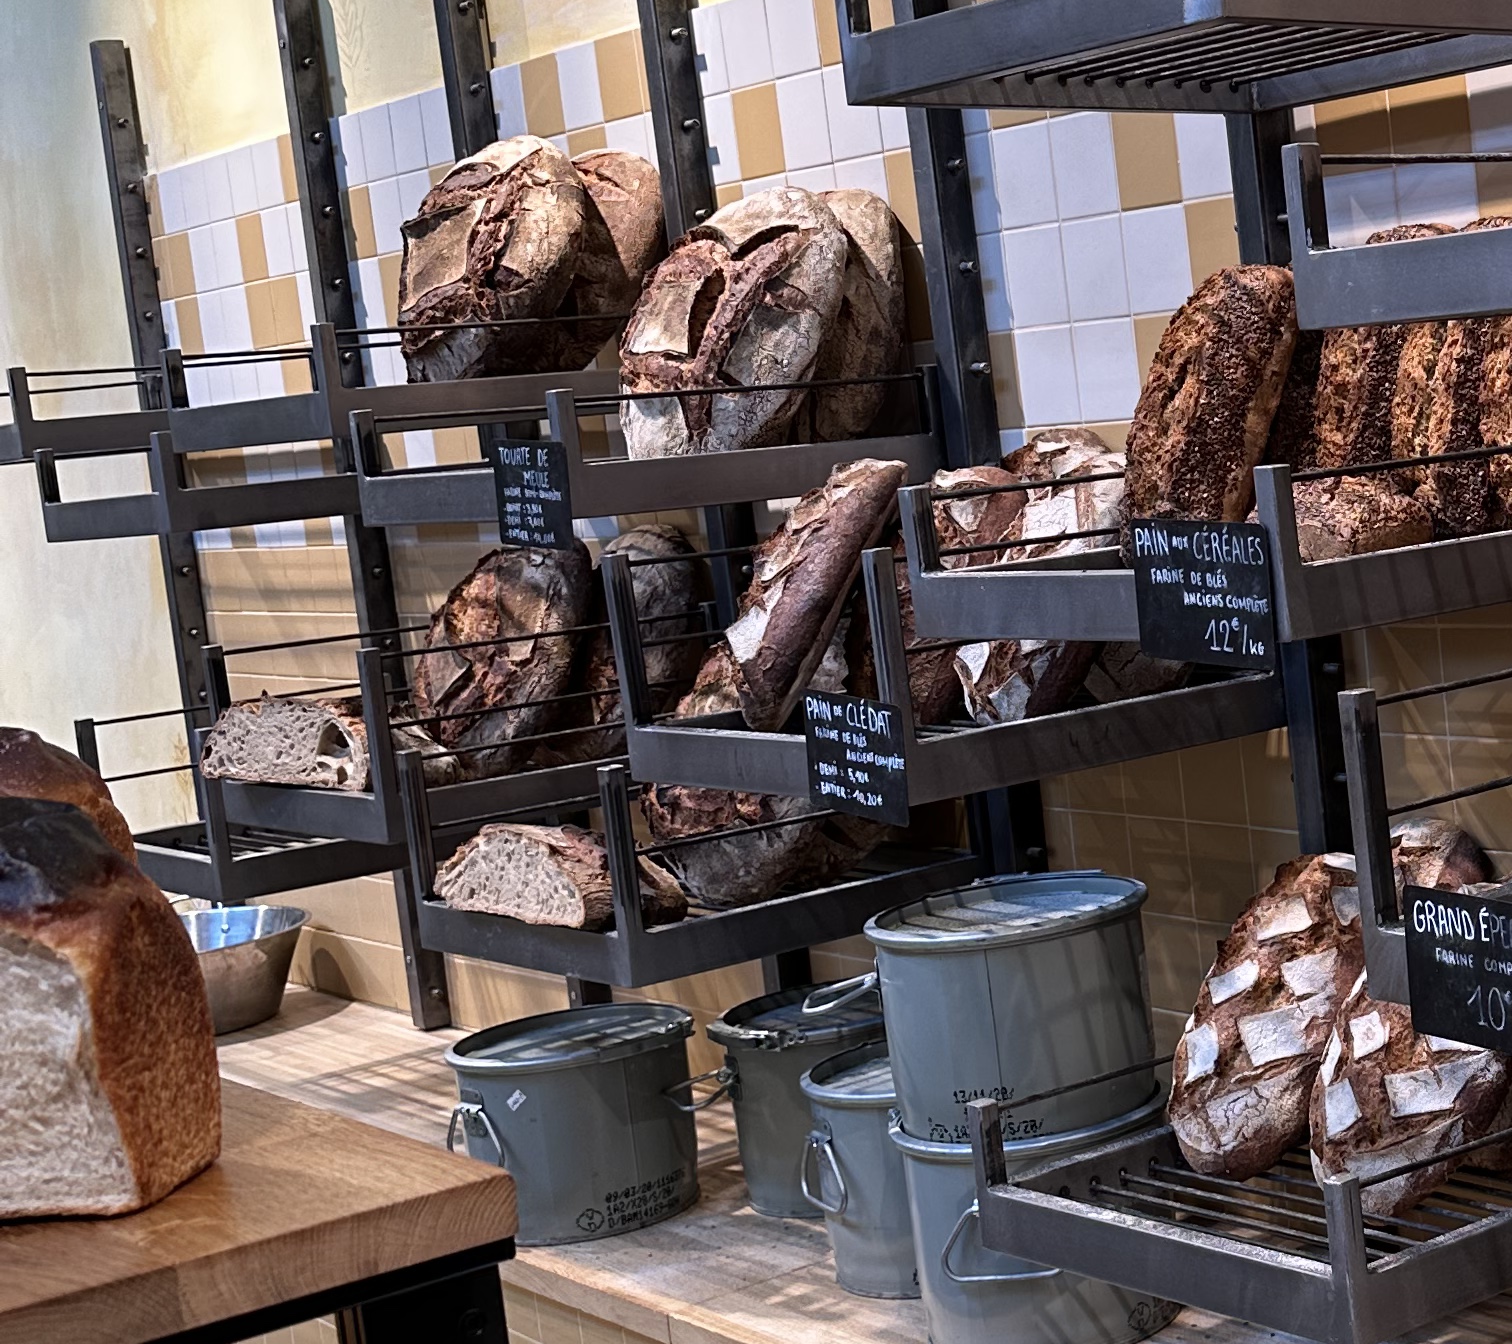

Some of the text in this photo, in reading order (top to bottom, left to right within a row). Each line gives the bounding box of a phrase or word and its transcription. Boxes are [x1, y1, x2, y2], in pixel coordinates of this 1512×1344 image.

[537, 448, 549, 467] DE
[1172, 536, 1189, 550] AUX
[1193, 525, 1265, 566] CÉRÉALES
[1190, 571, 1202, 586] DE
[1206, 569, 1228, 588] BLÉS
[833, 705, 843, 717] DE
[1413, 899, 1475, 940] GRAND
[1435, 946, 1475, 969] FARINE
